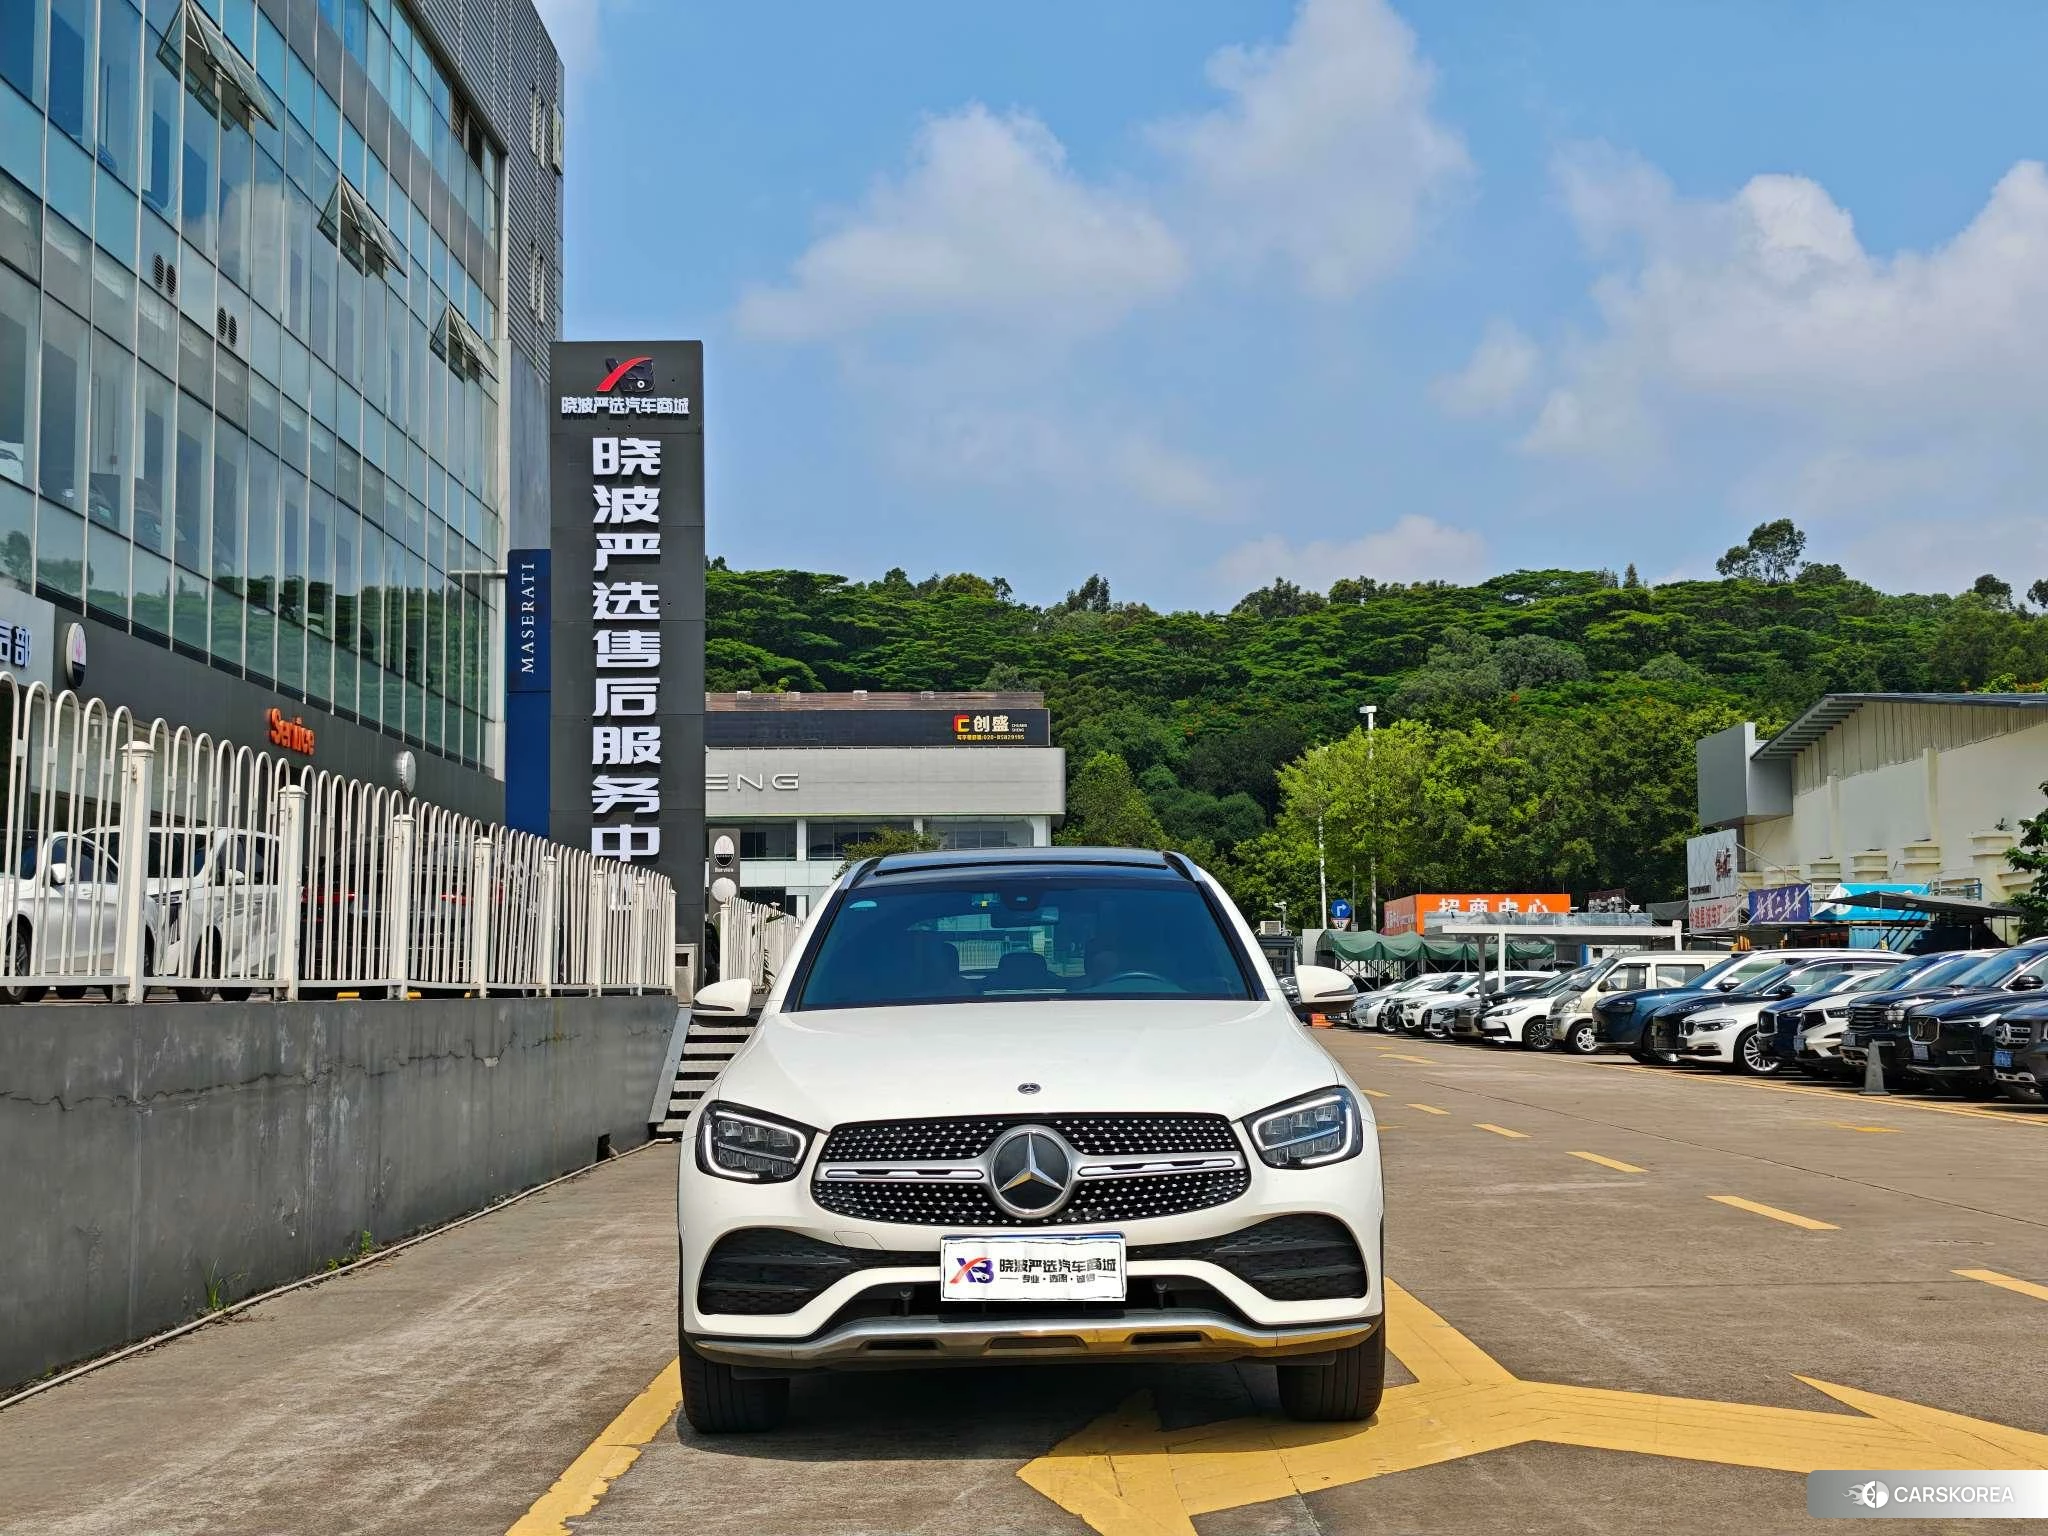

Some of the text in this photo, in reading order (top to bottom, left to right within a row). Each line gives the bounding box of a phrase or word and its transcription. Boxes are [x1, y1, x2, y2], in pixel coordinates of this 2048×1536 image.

[561, 396, 690, 414] 晓波严选汽车商城
[520, 562, 536, 675] MASERATI
[973, 714, 1010, 733] 创盛
[999, 1258, 1117, 1273] 晓波严选汽车商城
